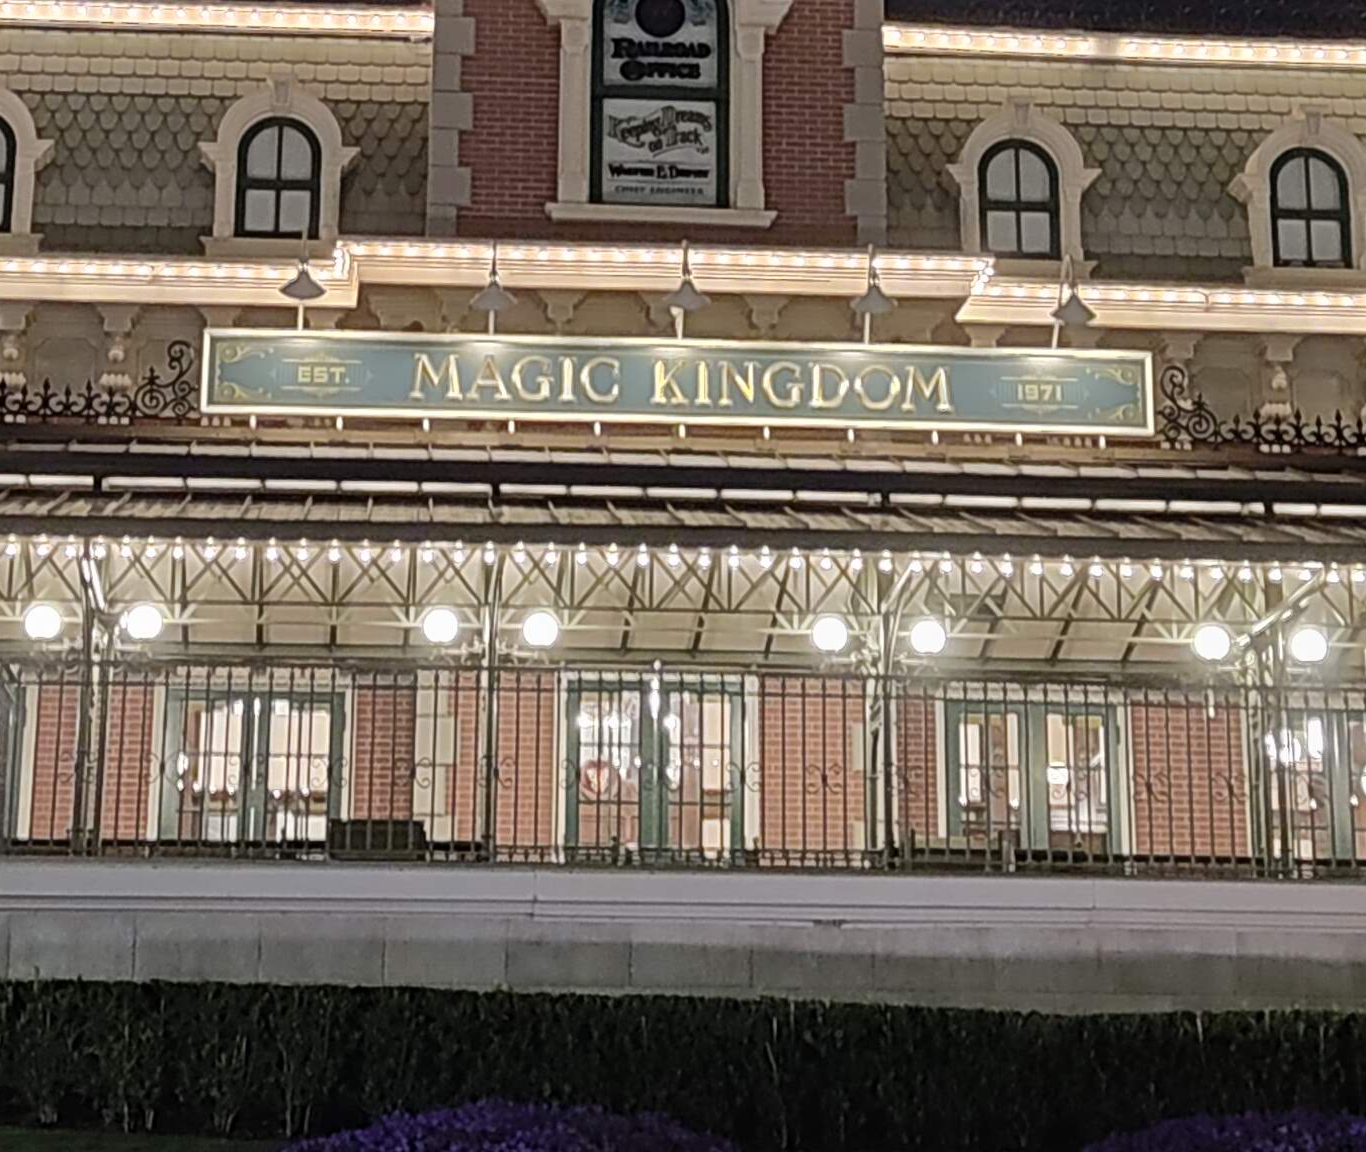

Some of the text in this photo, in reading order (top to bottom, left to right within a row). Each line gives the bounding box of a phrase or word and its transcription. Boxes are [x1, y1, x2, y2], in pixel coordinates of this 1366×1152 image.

[610, 37, 712, 59] RAILROAD
[619, 60, 702, 82] OFFICE
[296, 352, 1063, 415] EST. MAGIC KINGDOM 1971
